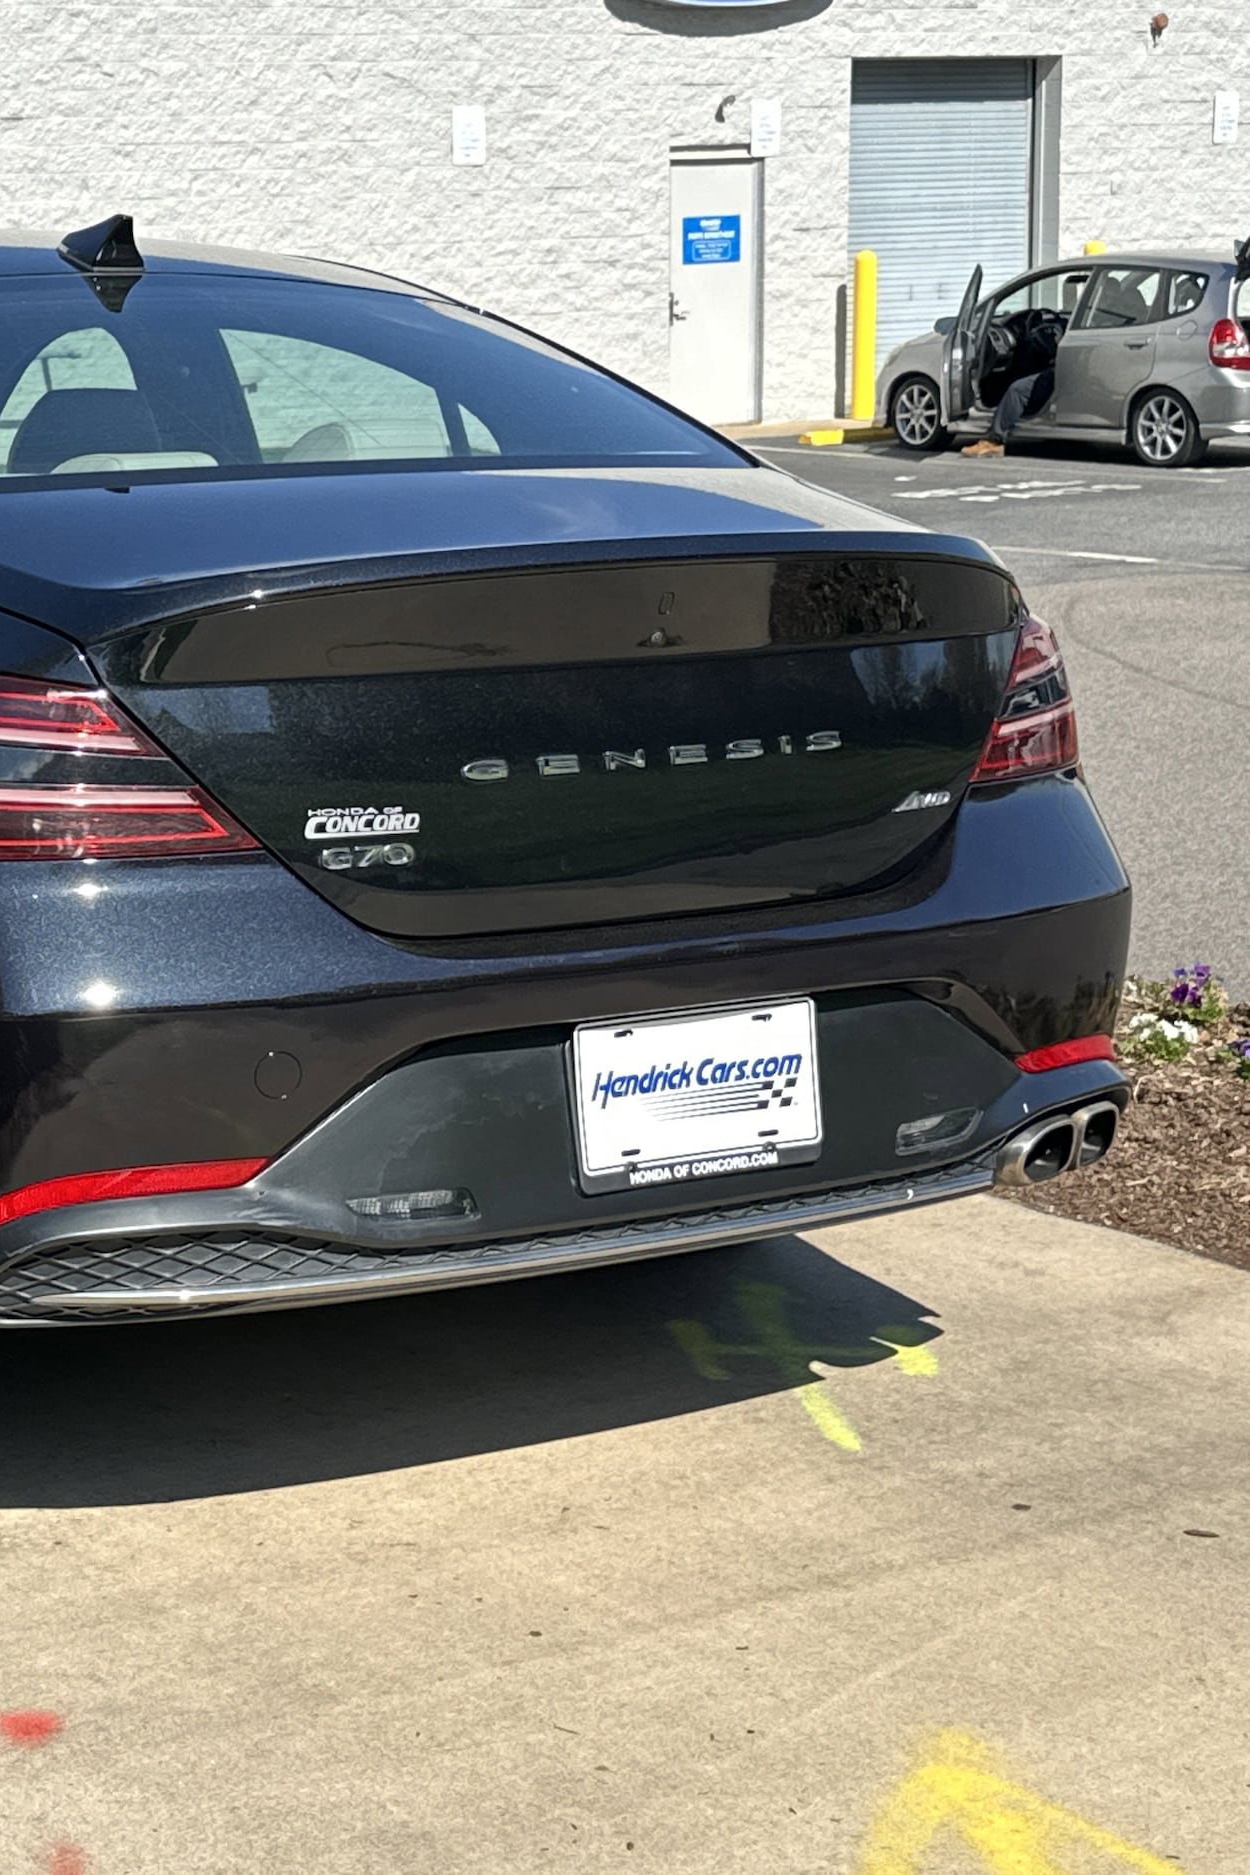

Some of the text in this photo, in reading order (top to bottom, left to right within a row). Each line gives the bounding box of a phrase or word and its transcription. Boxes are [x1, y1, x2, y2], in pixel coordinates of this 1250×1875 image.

[460, 730, 843, 782] GENESIS
[304, 812, 420, 839] CONCORD
[307, 806, 403, 817] HONDA OF
[320, 842, 415, 870] G70
[629, 1151, 778, 1185] HONDA OF CONCORD.COM
